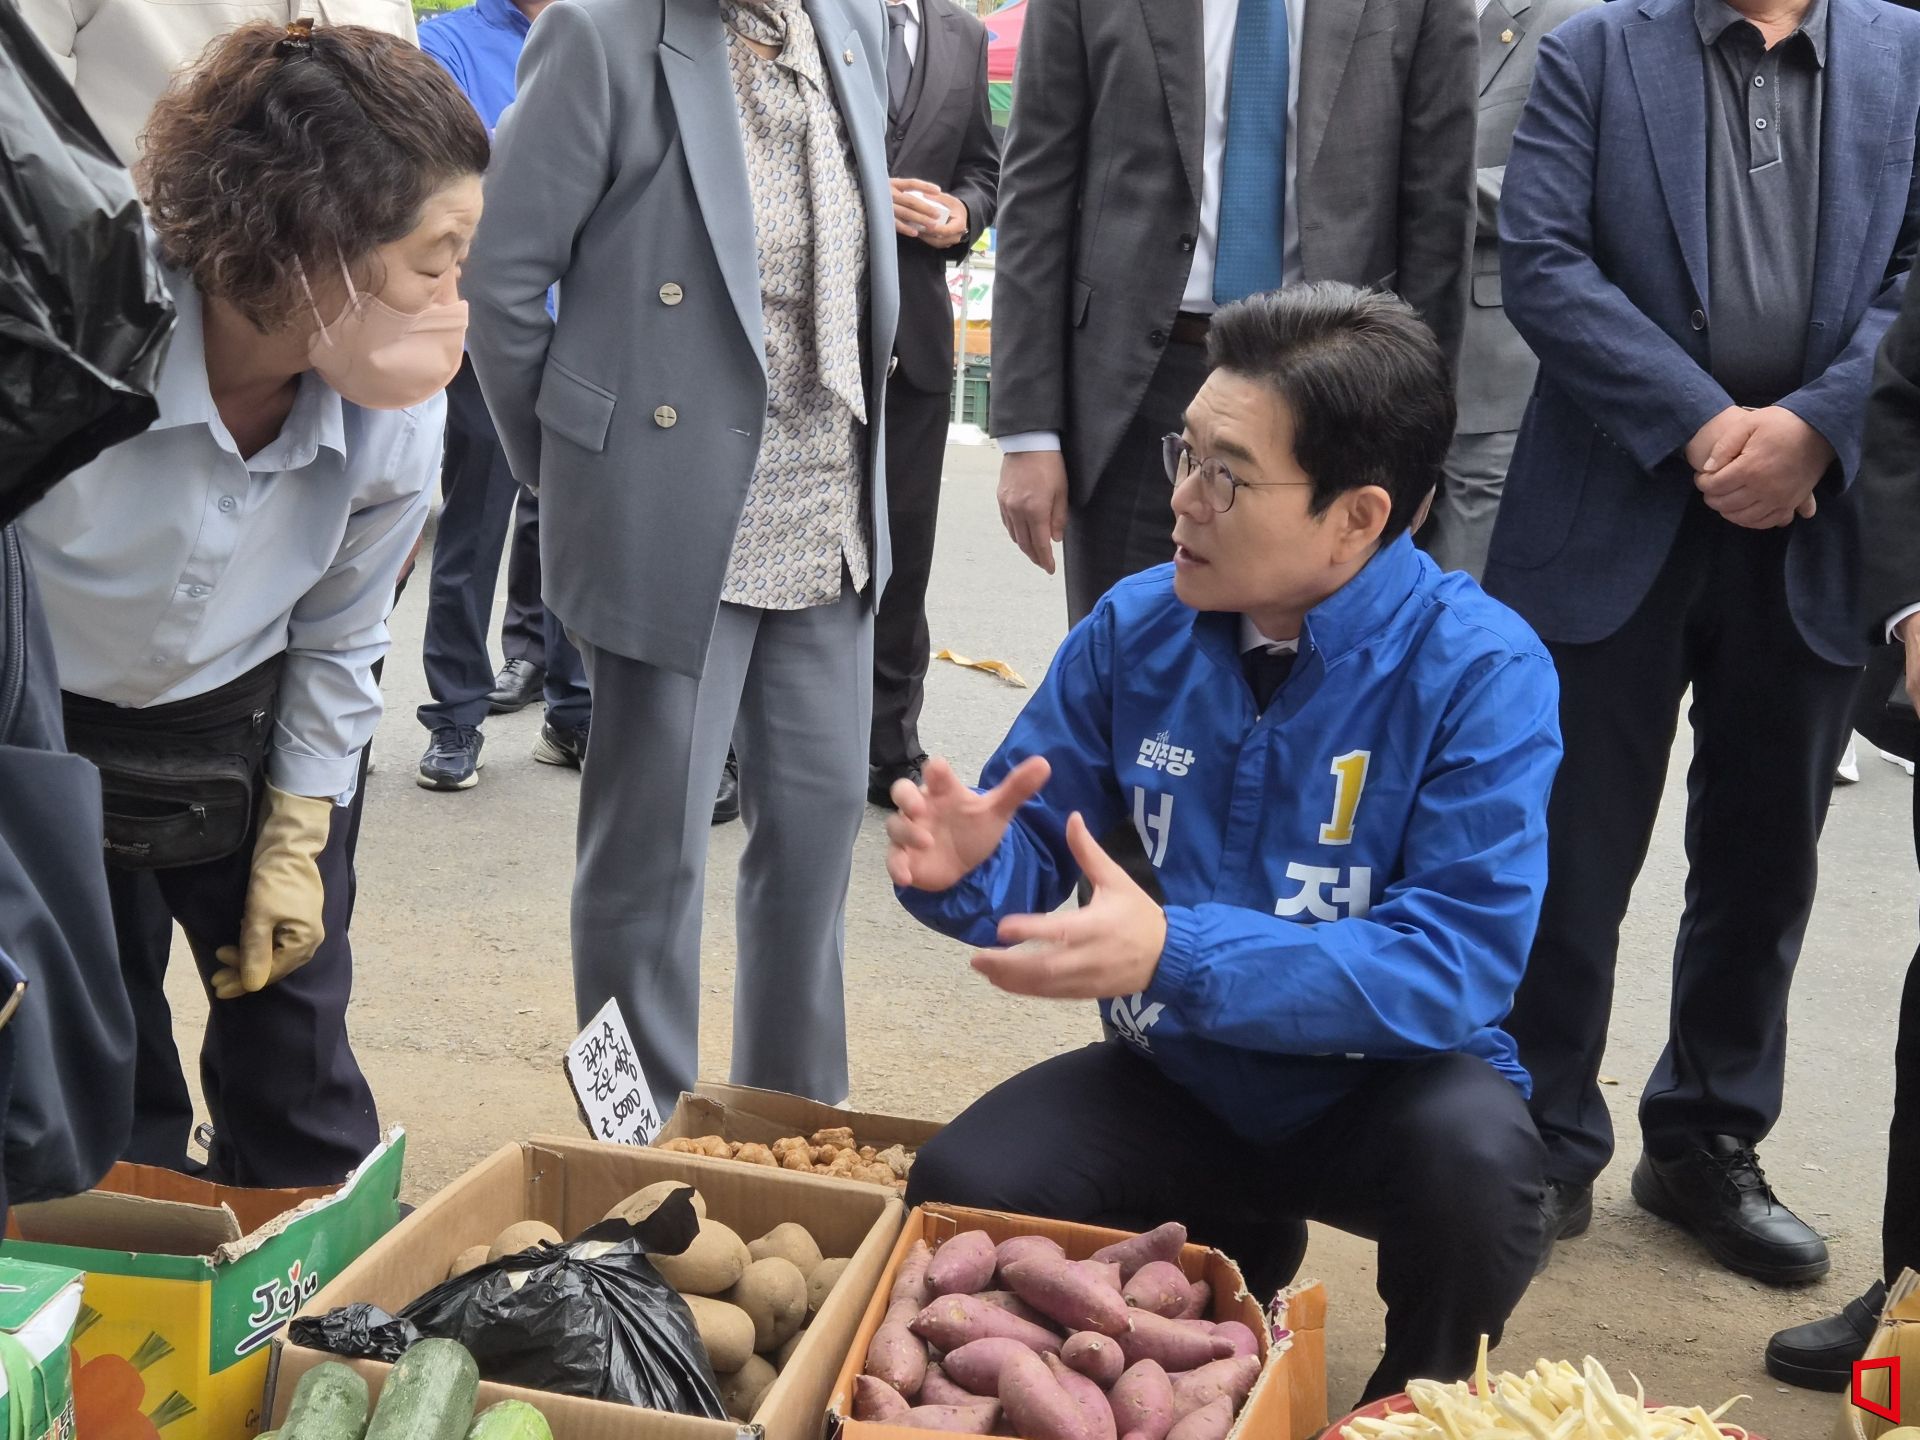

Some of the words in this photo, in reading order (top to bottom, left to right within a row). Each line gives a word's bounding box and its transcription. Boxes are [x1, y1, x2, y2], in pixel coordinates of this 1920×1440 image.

[1136, 737, 1196, 776] 민주당
[1319, 750, 1372, 846] 1
[249, 1260, 318, 1327] Jeju
